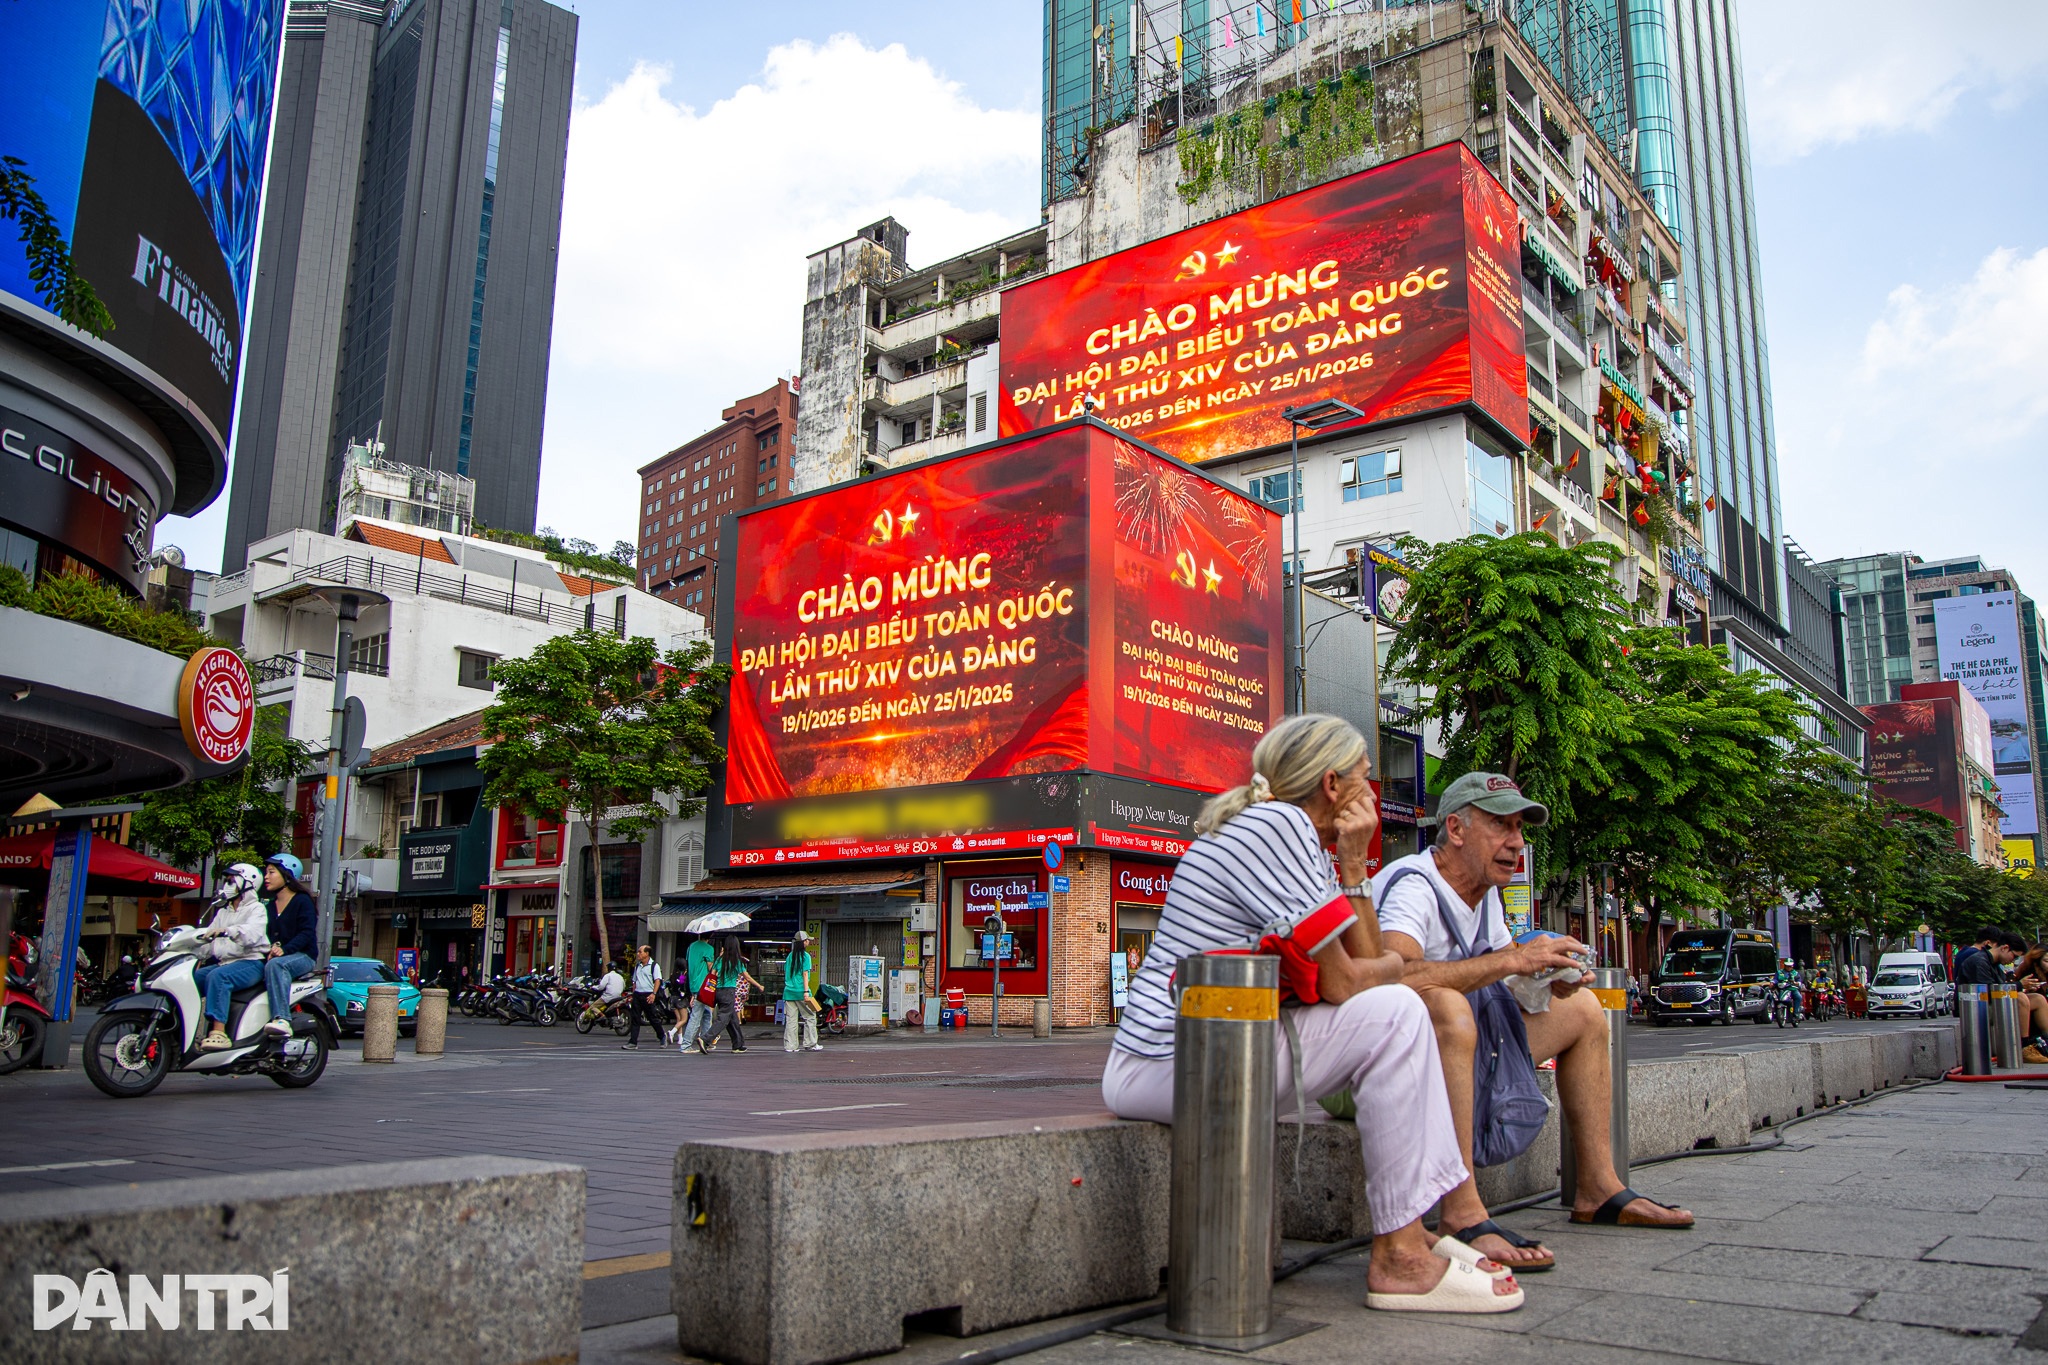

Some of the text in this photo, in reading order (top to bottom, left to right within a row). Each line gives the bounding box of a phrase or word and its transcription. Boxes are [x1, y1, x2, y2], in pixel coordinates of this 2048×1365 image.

[1520, 217, 1577, 297] Kangaroo
[131, 233, 233, 370] Finance
[1086, 260, 1339, 355] CHÀO MỪNG
[1012, 265, 1449, 407] ĐẠI HỘI ĐẠI BIỂU TOÀN QUỐC
[1054, 313, 1402, 423] LẦN THỨ XIV CỦA ĐẢNG
[1158, 395, 1201, 419] ĐẾN
[1207, 380, 1265, 407] NGÀY
[1269, 353, 1374, 392] 25/1/2026
[1593, 342, 1644, 409] Kangaroo
[1623, 394, 1646, 425] LETTER
[1561, 475, 1593, 516] FADO
[798, 552, 992, 624] CHÀO MỪNG
[1669, 547, 1690, 582] THE
[1690, 565, 1709, 598] ONE
[741, 581, 1074, 676] ĐẠI HỘI ĐẠI BIỂU TOÀN QUỐC
[1151, 619, 1239, 664] CHÀO MỪNG
[1960, 636, 1995, 648] Legend
[198, 654, 251, 709] HIGHLANDS
[770, 635, 1036, 704] LẦN THỨ XIV CỦA ĐẢNG
[1122, 641, 1264, 696] ĐẠI HỘI ĐẠI BIỂU TOÀN QUỐC
[1140, 664, 1252, 709] LẦN THỨ XIV CỦA ĐẢNG
[1962, 669, 1977, 679] TAN
[1979, 667, 2001, 677] RANG
[2003, 665, 2018, 675] XAY
[781, 683, 1013, 734] 19/1/2026 ĐẾN NGÀY 25/1/2026
[1123, 684, 1264, 734] 19/1/2026 ĐẾN NGÀY 25/1/2026
[200, 725, 241, 757] COFFEE
[1111, 800, 1190, 826] Happy New Year
[409, 844, 451, 855] THE BODY SHOP
[1102, 832, 1123, 847] Happy
[1122, 835, 1134, 845] New
[1134, 837, 1149, 848] Year
[1151, 839, 1164, 848] SALE
[154, 872, 195, 886] HIGHLANDS
[970, 881, 1028, 900] Gong cha
[1119, 870, 1153, 895] Gong
[422, 906, 472, 918] THE BODY SHO
[522, 894, 556, 910] MAROU
[967, 902, 996, 912] Brewin
[493, 943, 504, 954] LA
[809, 923, 819, 933] 97
[1096, 921, 1107, 933] 52
